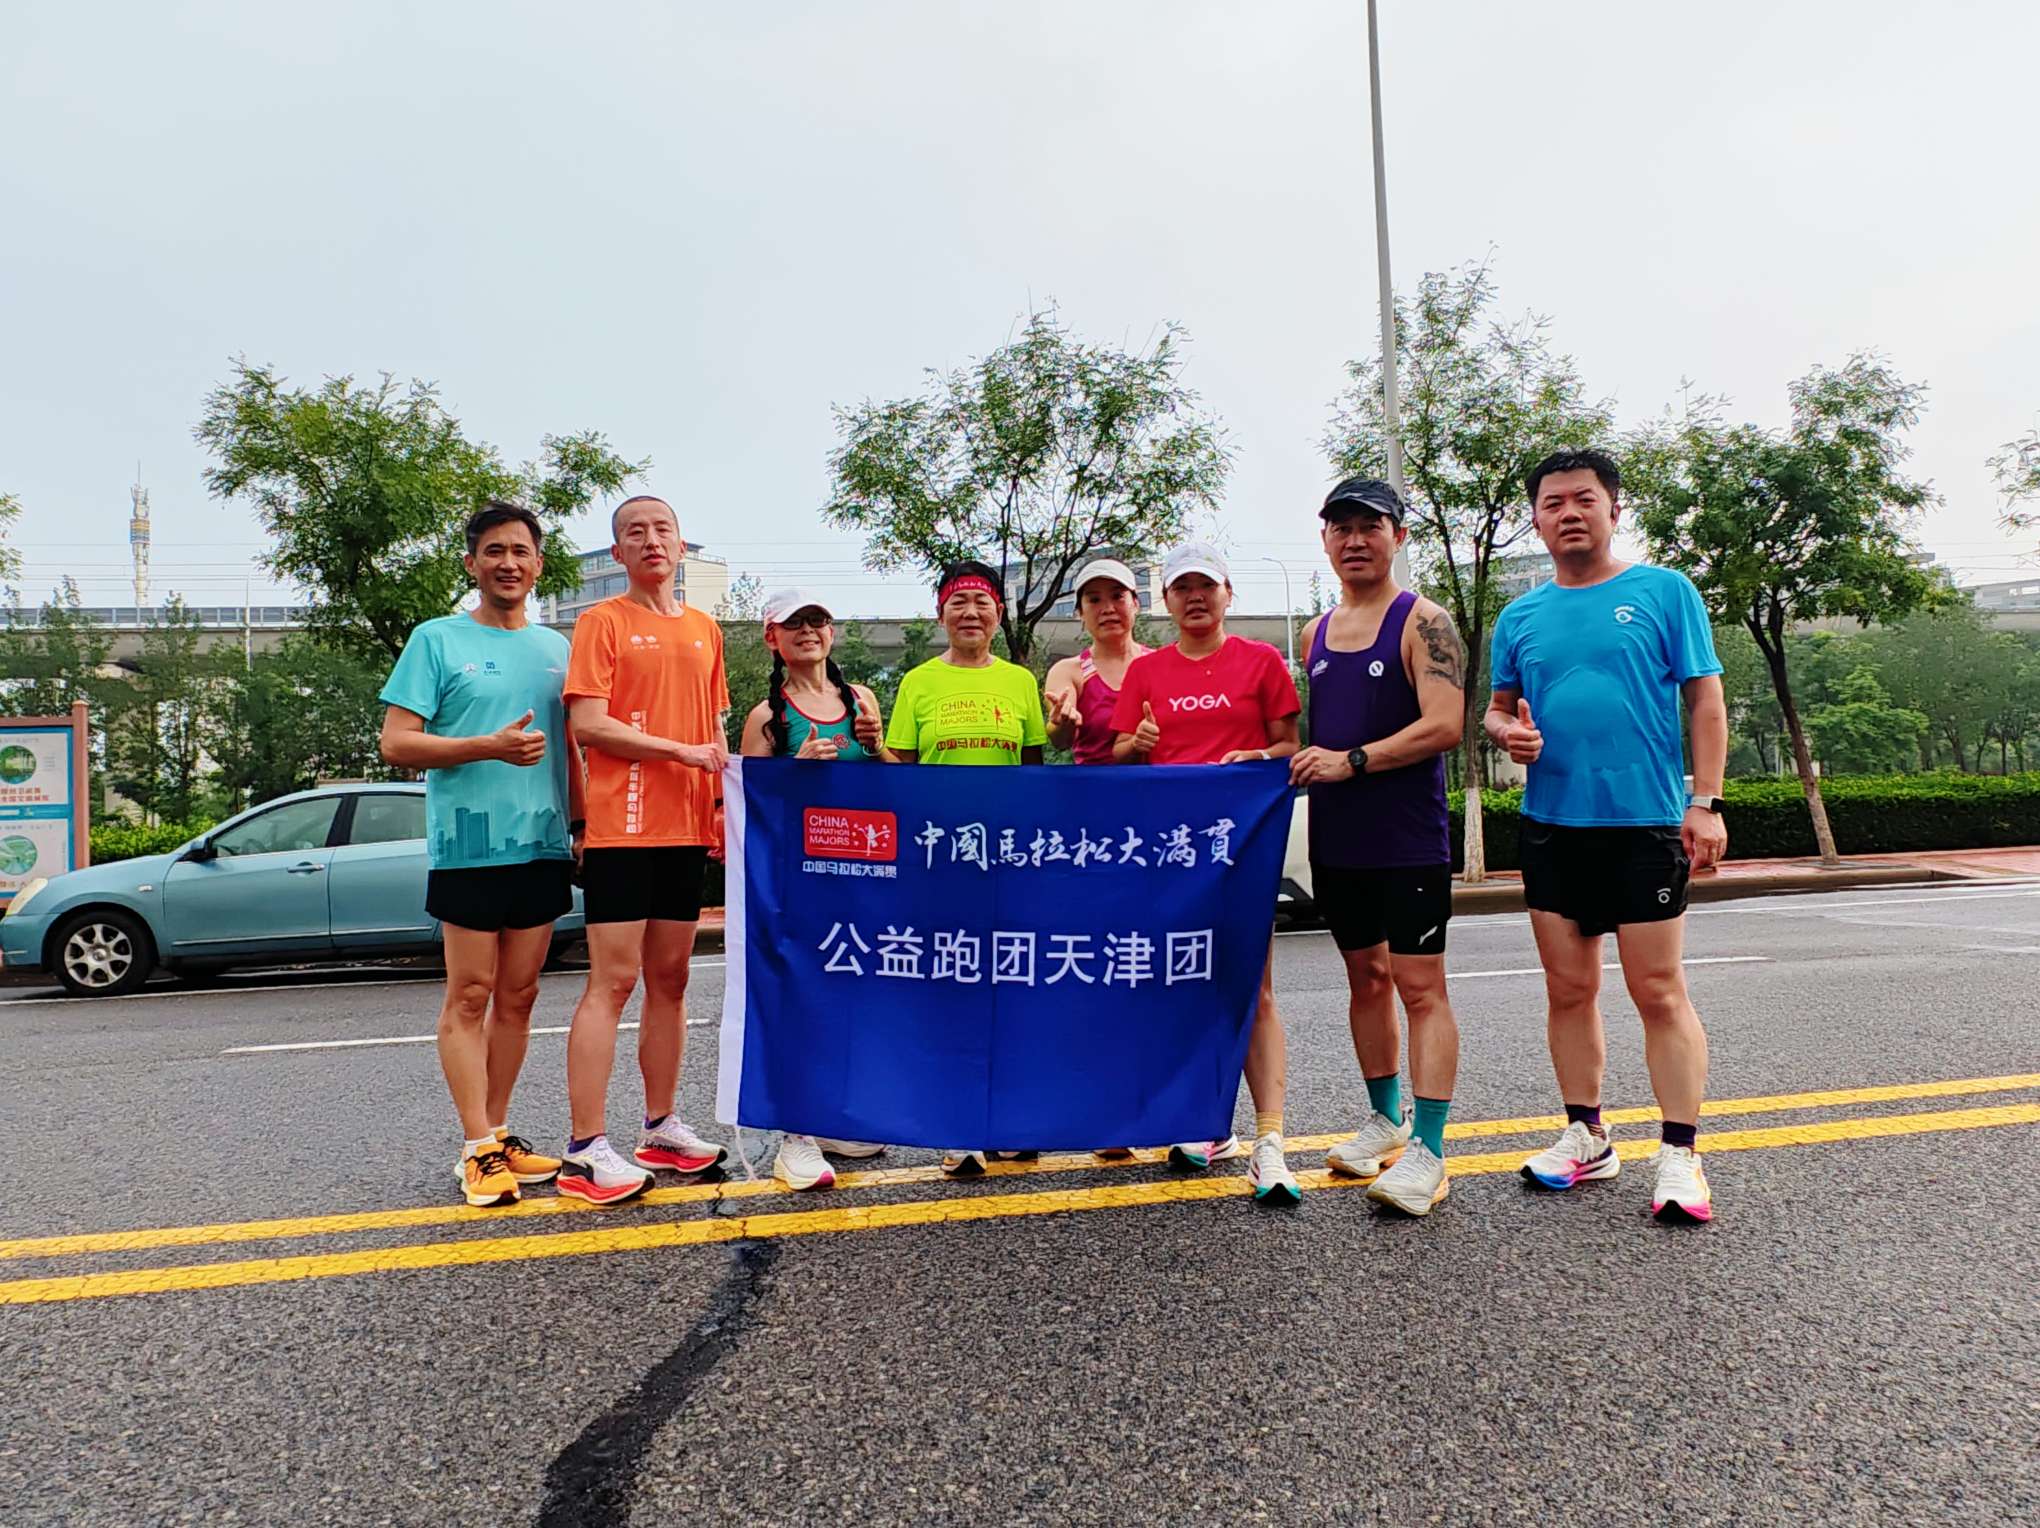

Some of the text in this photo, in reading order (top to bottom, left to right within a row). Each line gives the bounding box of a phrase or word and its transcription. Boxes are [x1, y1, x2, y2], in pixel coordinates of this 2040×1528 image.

[940, 700, 977, 713] CHINA
[1168, 693, 1232, 712] YOGA
[940, 716, 978, 726] MAJORS
[809, 814, 849, 828] CHINA
[809, 827, 850, 837] MARATHON
[809, 835, 850, 846] MAJORS
[818, 922, 1214, 988] 公益跑团天津团
